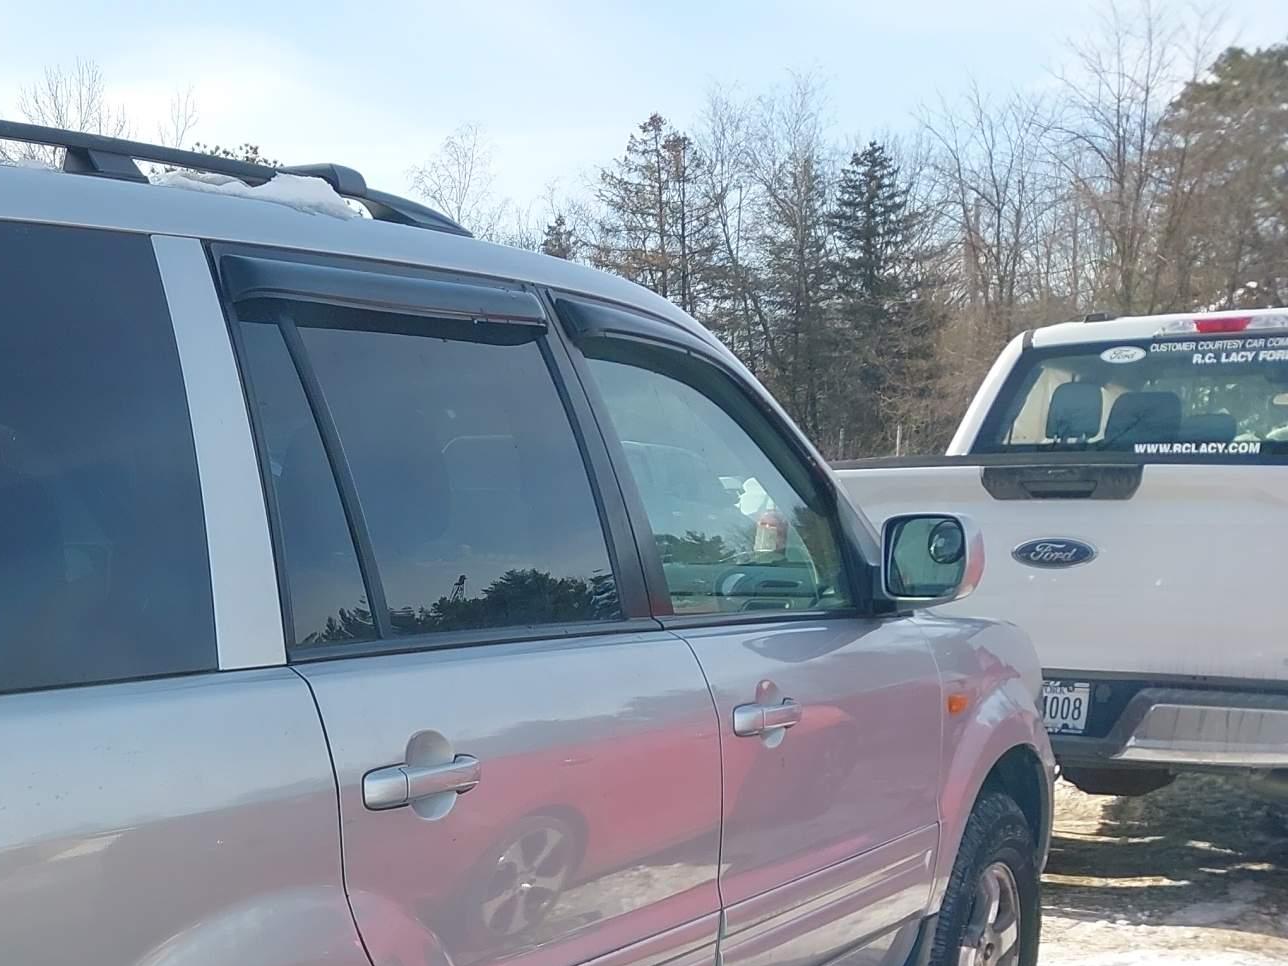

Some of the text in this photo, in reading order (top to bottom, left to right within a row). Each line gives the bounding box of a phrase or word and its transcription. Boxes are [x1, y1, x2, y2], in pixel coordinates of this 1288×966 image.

[1150, 342, 1196, 352] CUSTOMER
[1198, 340, 1244, 350] COURTESY
[1246, 339, 1265, 348] CAR
[1192, 353, 1217, 364] R.C.
[1221, 351, 1256, 363] LACY
[1134, 442, 1261, 454] WWW.RCLACY.COM
[1030, 543, 1077, 561] Ford
